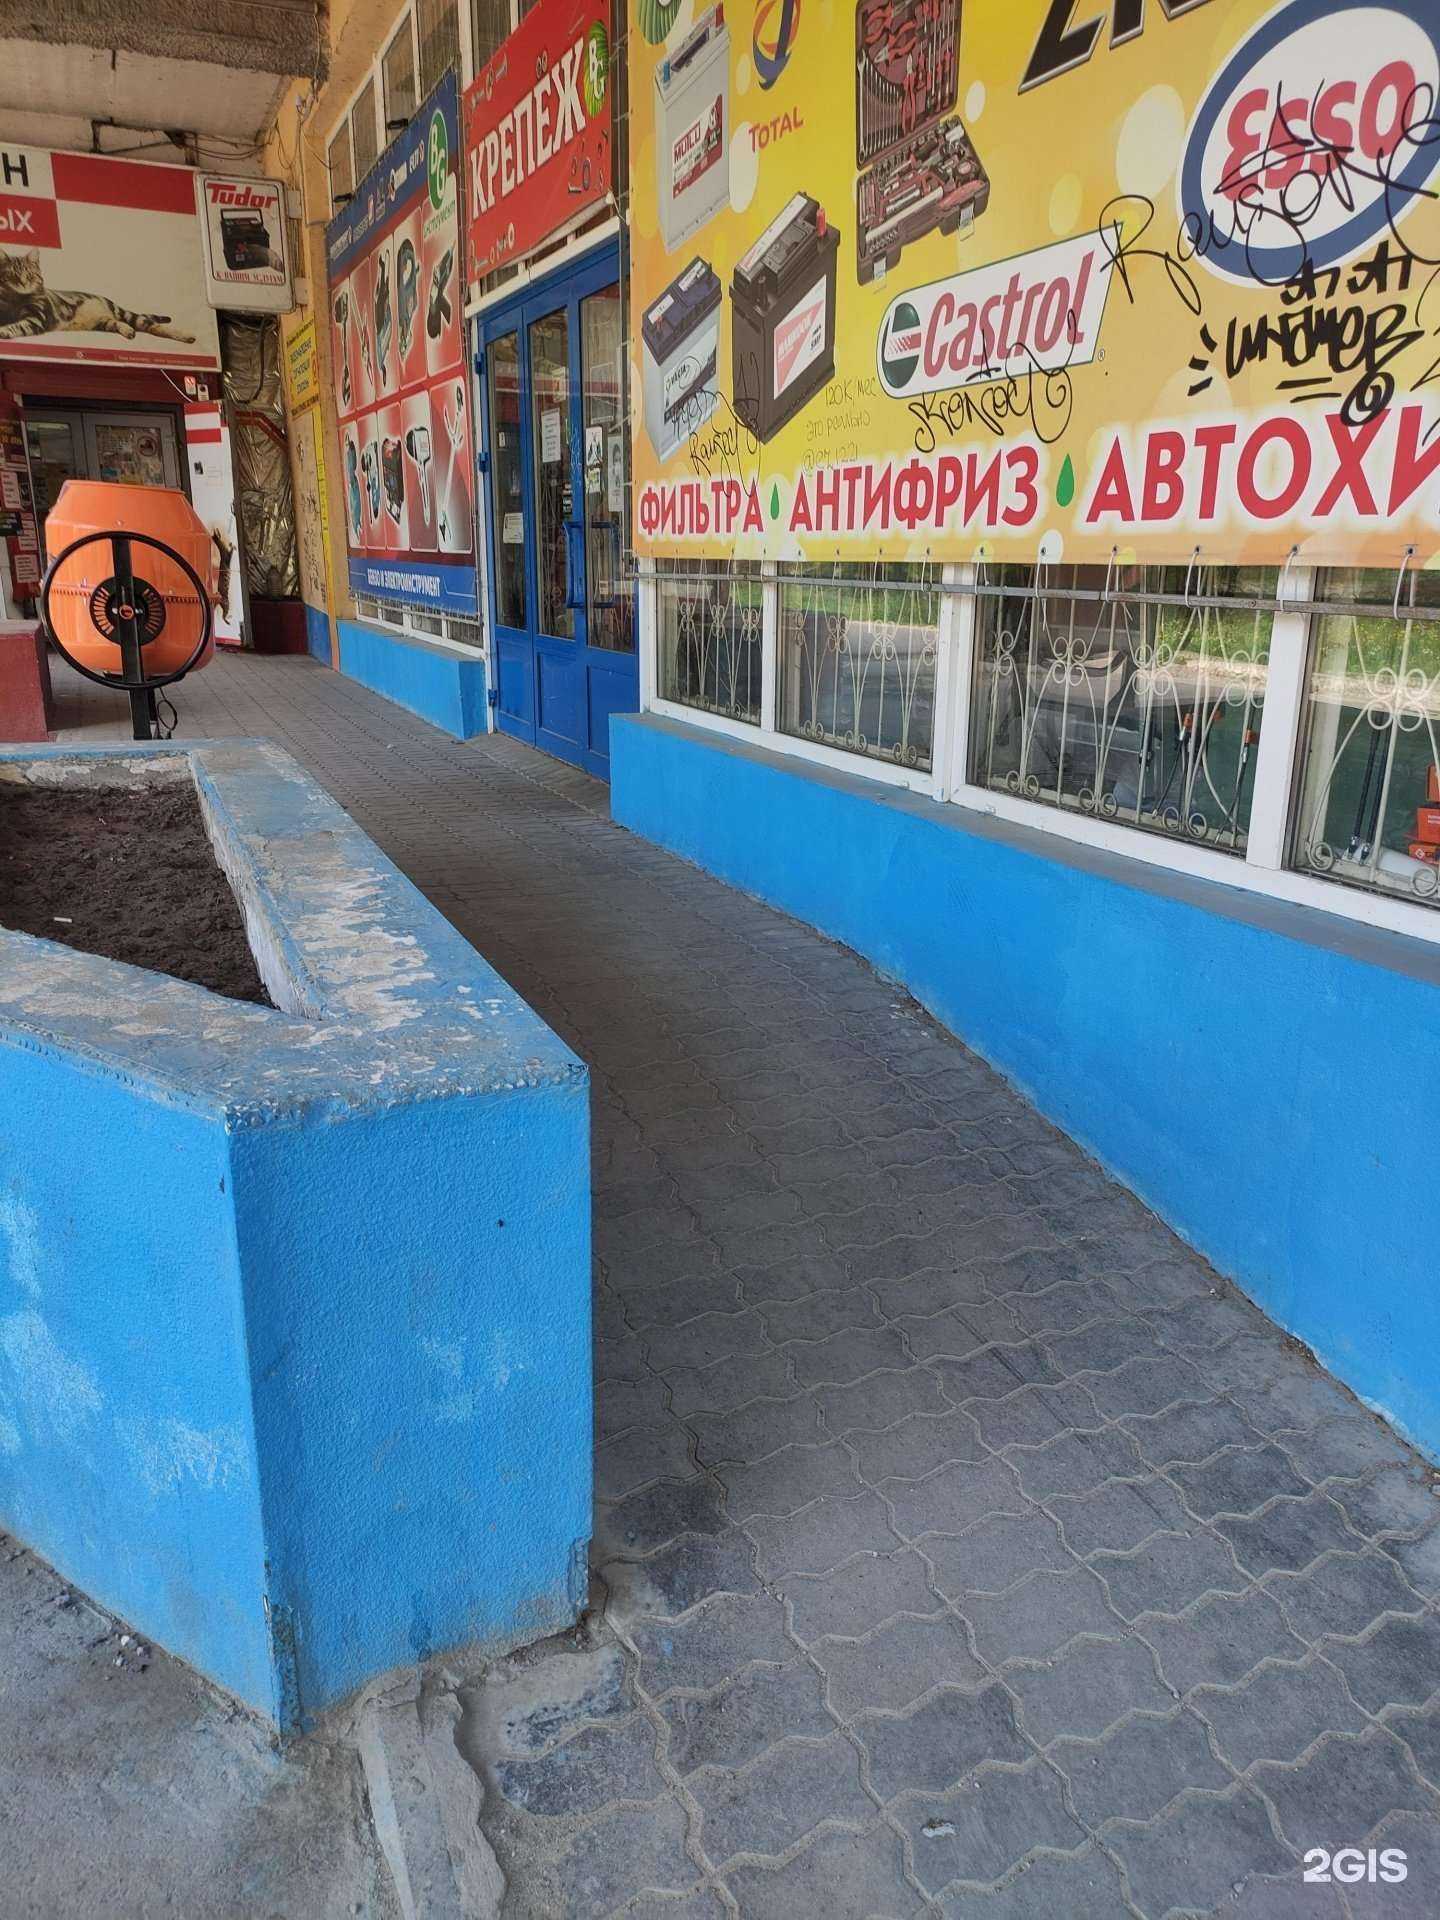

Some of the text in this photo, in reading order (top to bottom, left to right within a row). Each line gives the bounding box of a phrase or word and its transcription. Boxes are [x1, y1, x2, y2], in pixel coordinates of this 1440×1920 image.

[206, 182, 278, 209] Tudor
[923, 251, 1095, 378] Castrol
[640, 477, 763, 536] ФИЛЬТРА
[789, 445, 1039, 533] АНТИФРИЗ
